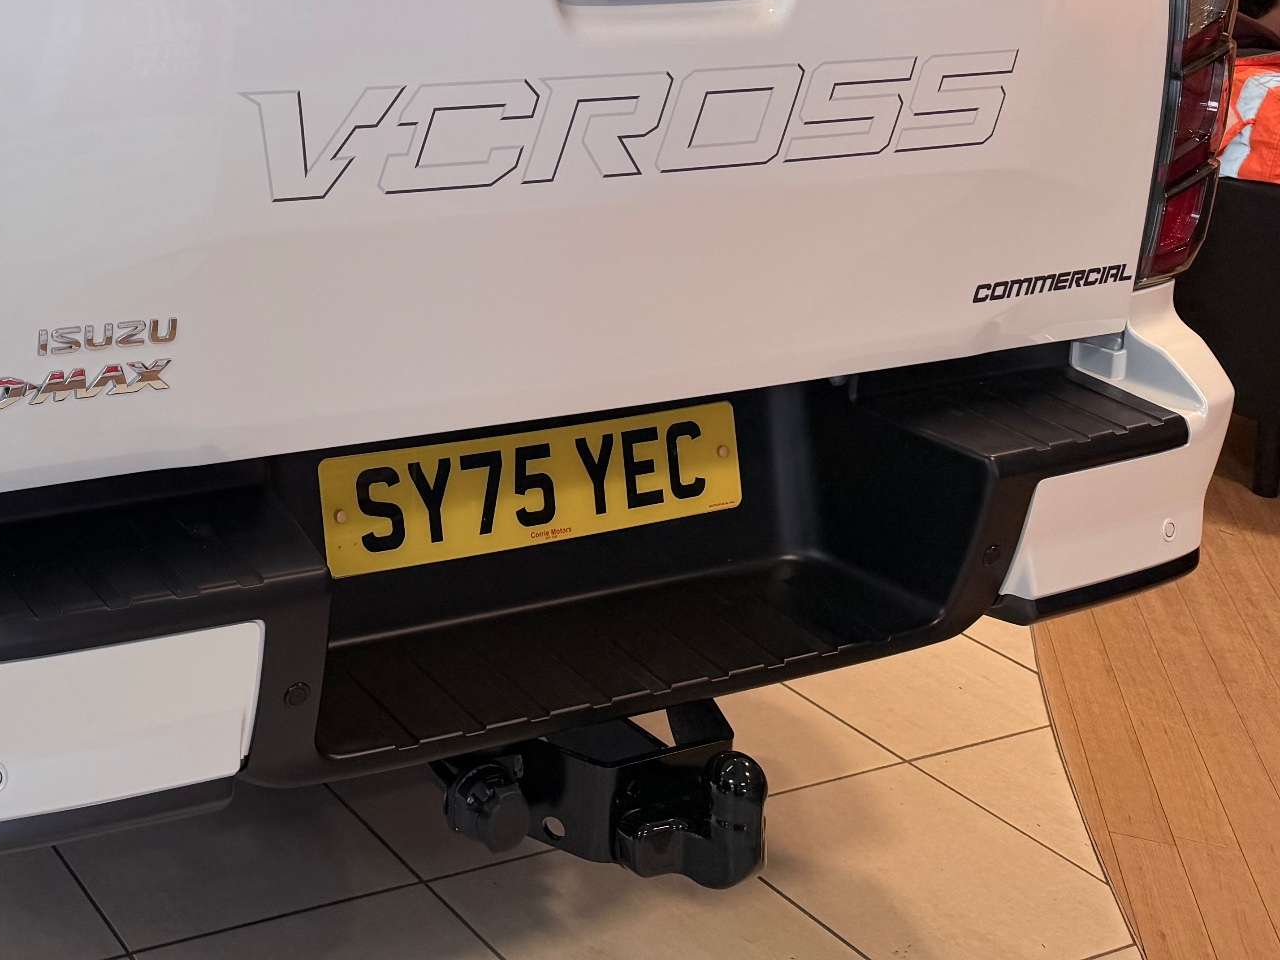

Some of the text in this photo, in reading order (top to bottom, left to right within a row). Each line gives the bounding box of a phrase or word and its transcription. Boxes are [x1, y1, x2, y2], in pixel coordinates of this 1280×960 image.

[972, 263, 1133, 304] COMMERCIAL
[37, 317, 178, 356] ISUZU
[355, 420, 706, 553] SY75 YEC
[551, 527, 572, 536] Motors
